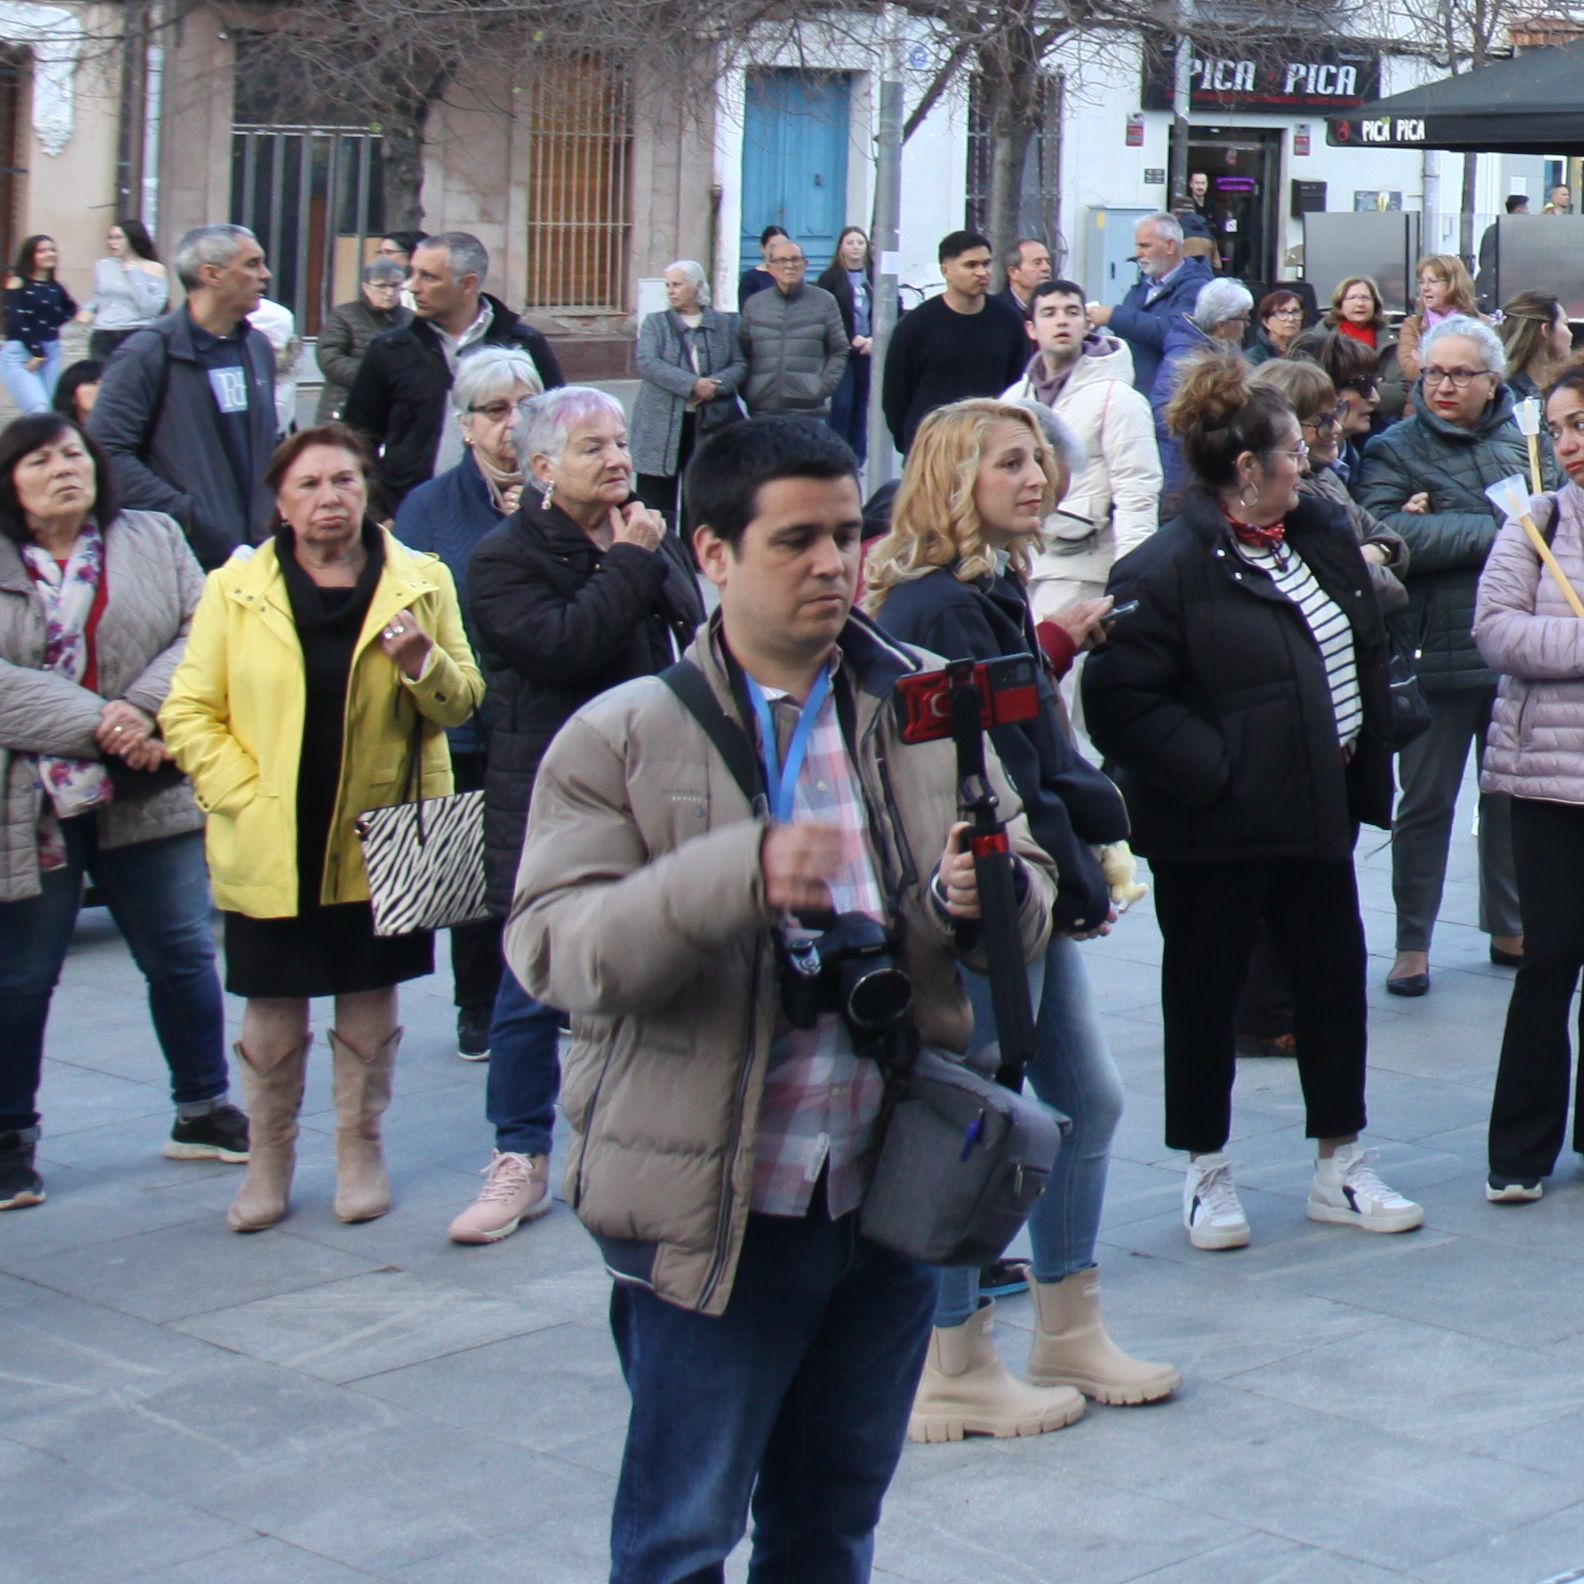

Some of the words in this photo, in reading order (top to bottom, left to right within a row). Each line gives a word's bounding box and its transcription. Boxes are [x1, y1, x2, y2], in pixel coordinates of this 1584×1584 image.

[1282, 62, 1358, 96] PICA
[1362, 119, 1391, 142] PICA
[1396, 118, 1426, 142] PICA
